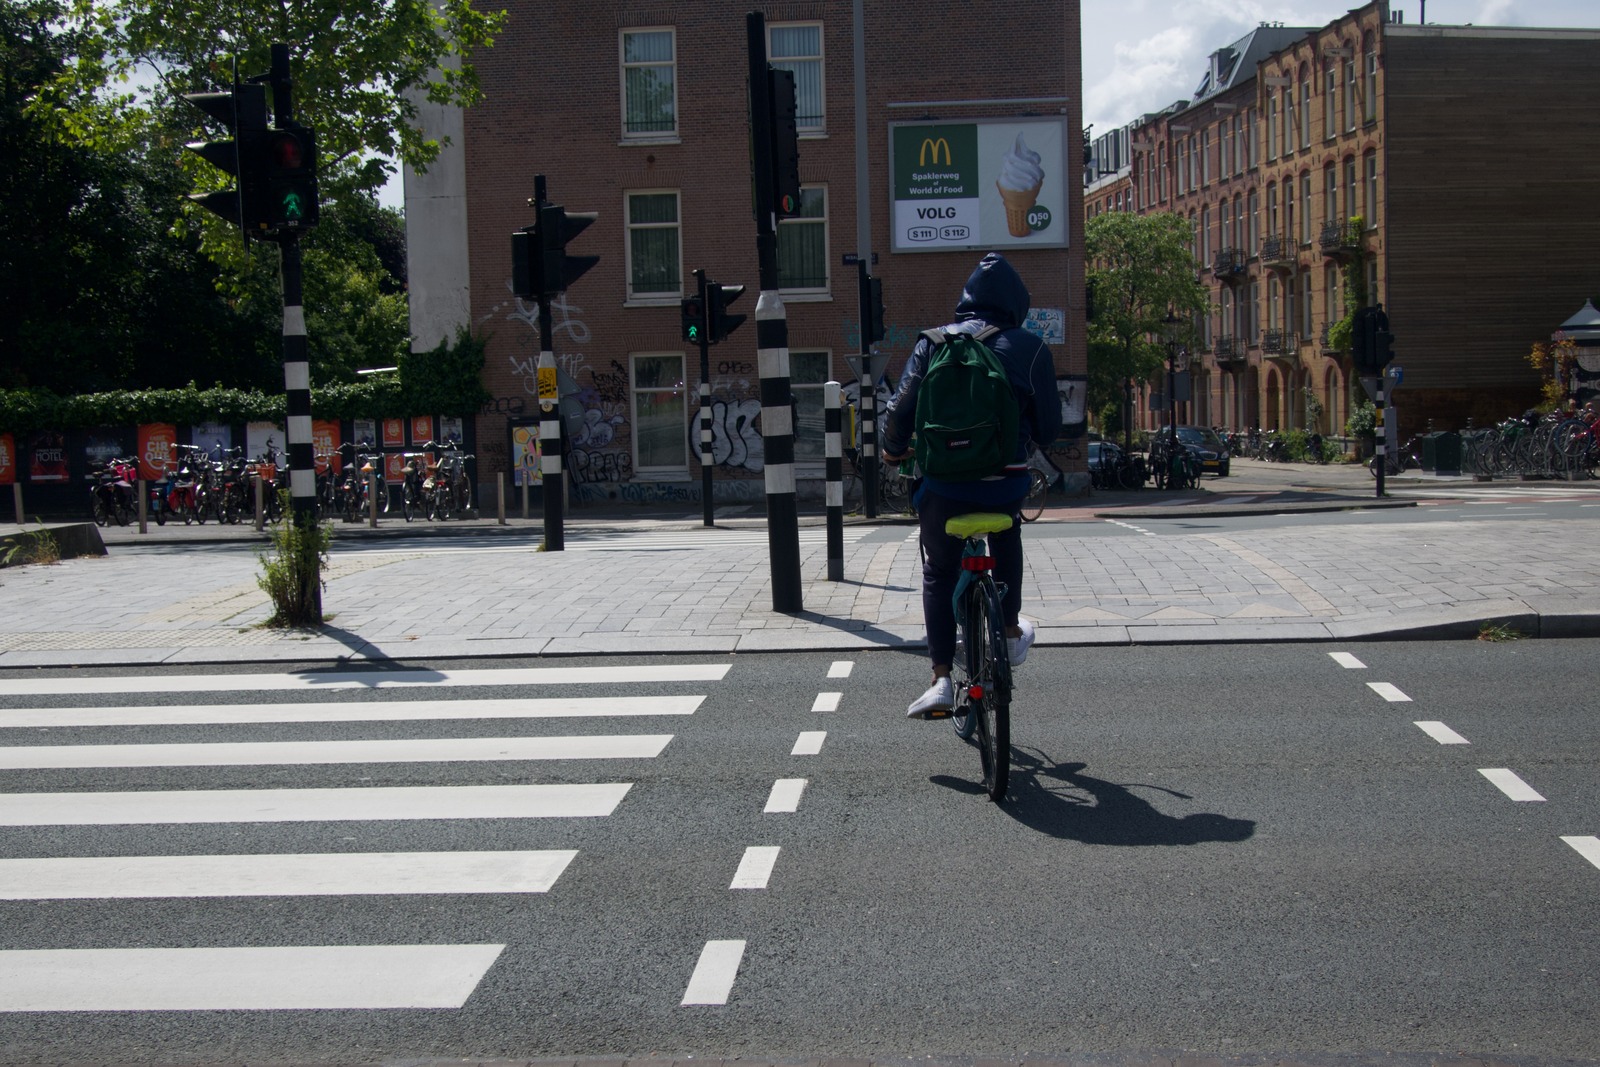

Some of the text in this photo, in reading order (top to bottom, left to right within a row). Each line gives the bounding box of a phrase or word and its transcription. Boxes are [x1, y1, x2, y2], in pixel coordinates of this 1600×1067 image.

[912, 172, 960, 182] Spaklerweg
[909, 185, 963, 194] World of Food
[916, 206, 957, 220] VOLG
[912, 230, 932, 239] S 111
[944, 228, 965, 237] S 112
[35, 451, 64, 462] HOTEL
